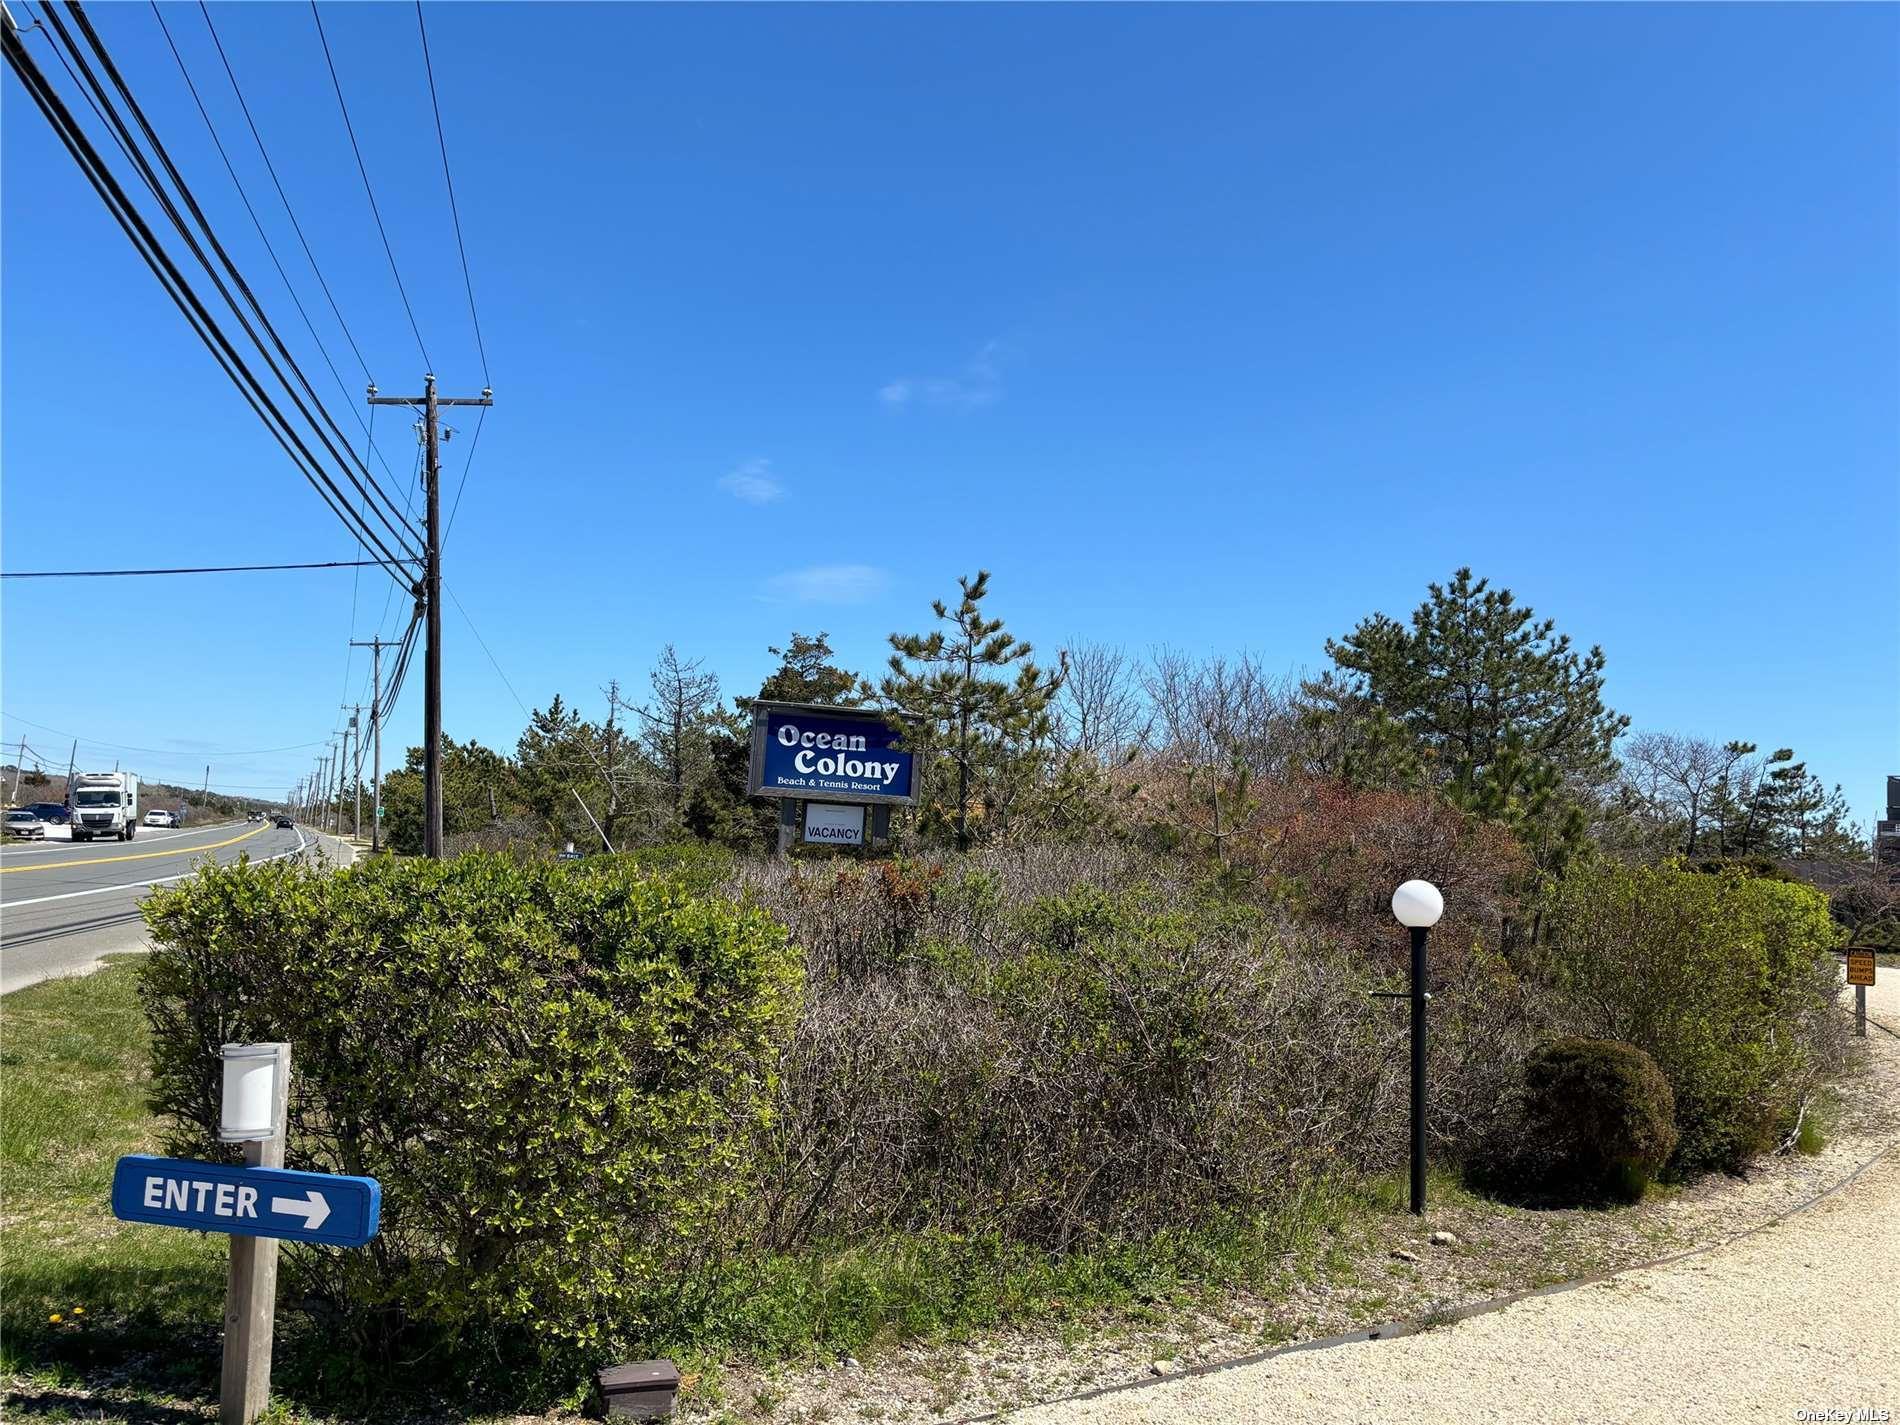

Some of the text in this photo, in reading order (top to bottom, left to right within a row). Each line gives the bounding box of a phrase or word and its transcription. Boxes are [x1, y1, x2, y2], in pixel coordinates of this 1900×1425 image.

[777, 724, 867, 752] Ocean
[794, 750, 900, 785] Colony
[777, 776, 880, 791] Beach & Tennis Resort
[808, 826, 860, 840] VACANCY
[143, 1176, 258, 1219] ENTER
